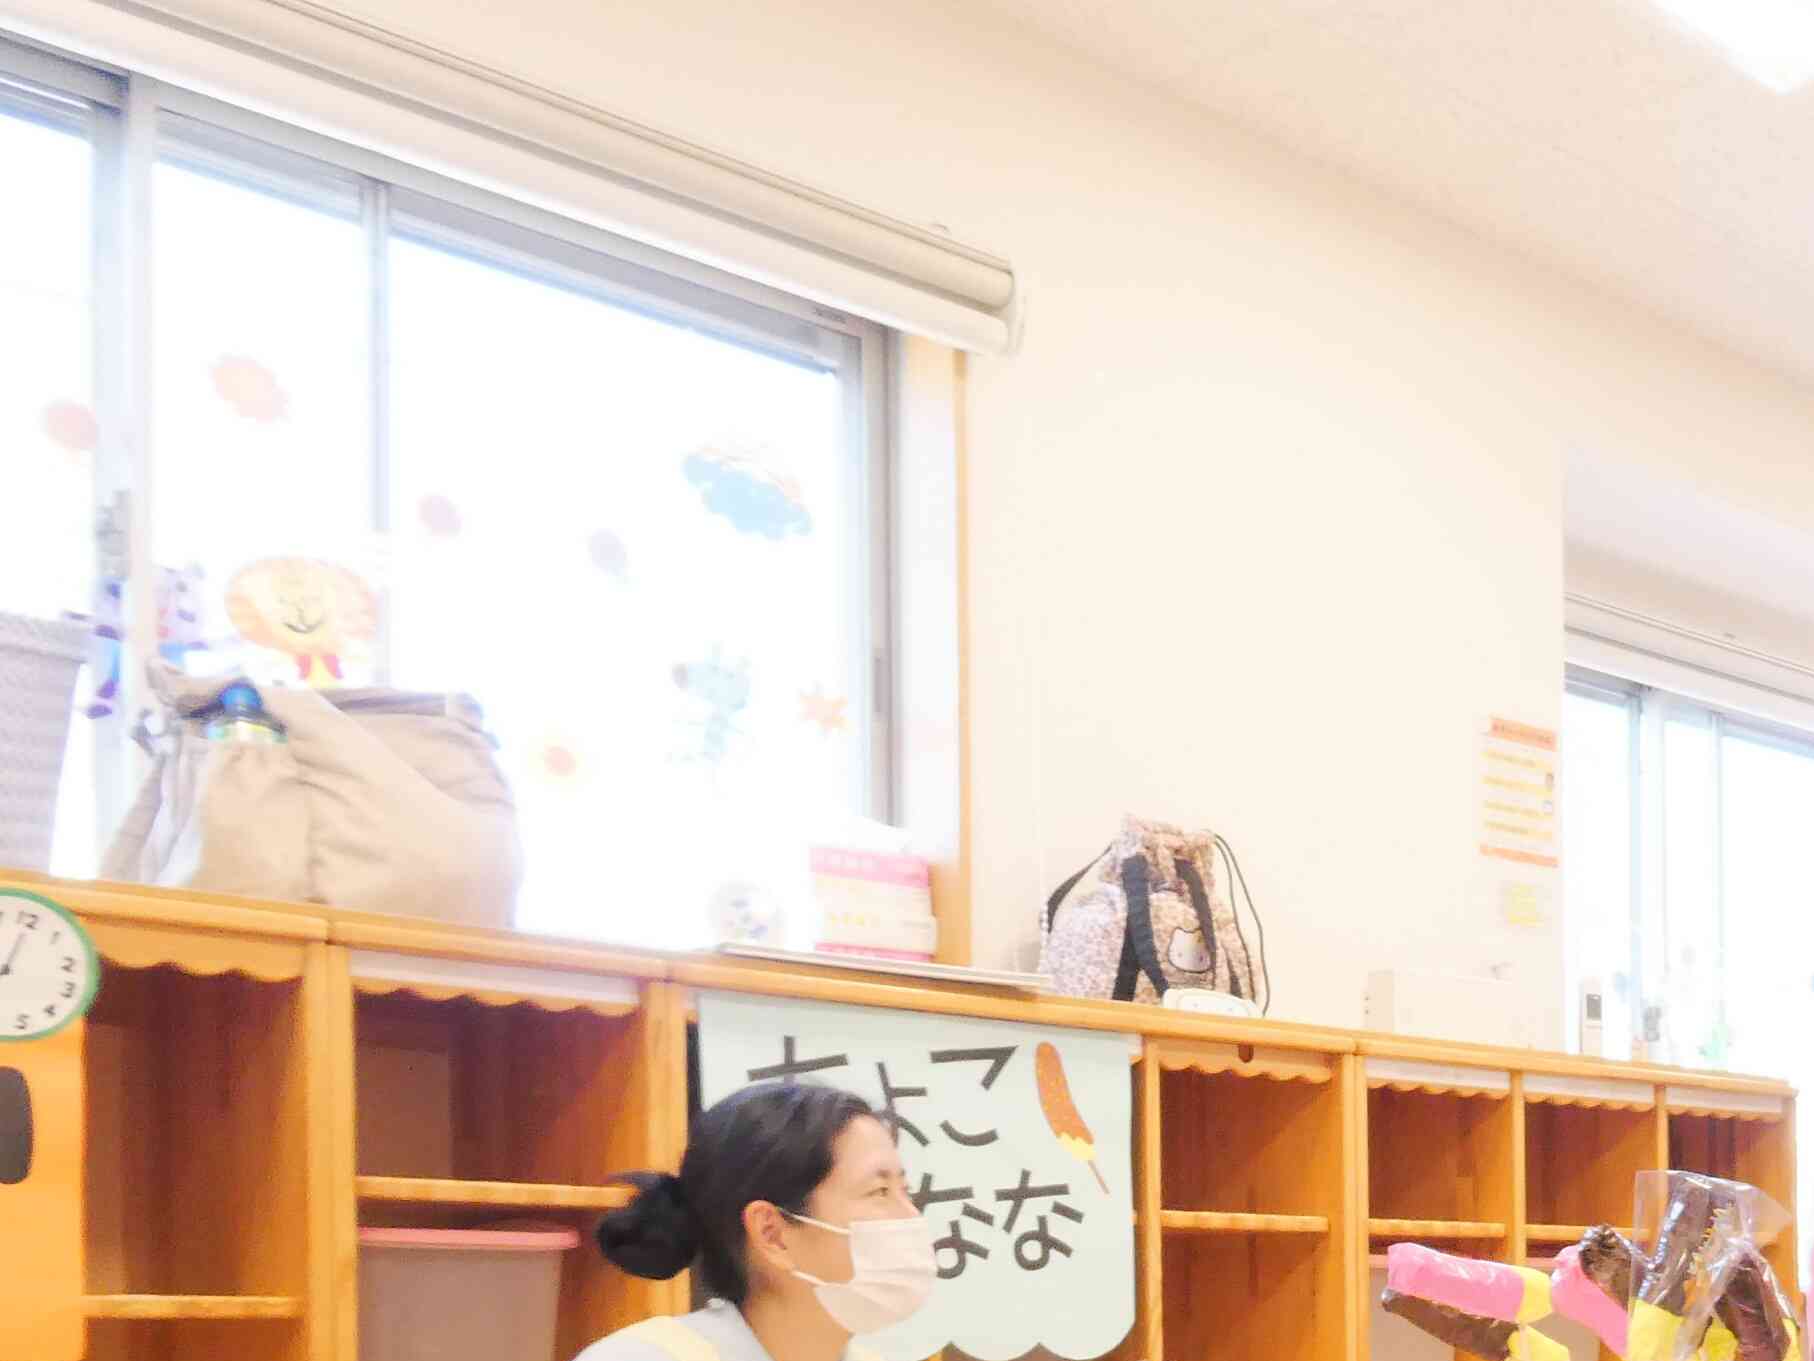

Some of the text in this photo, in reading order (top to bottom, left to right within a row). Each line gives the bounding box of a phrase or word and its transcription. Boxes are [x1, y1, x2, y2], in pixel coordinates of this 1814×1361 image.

[16, 910, 39, 931] 12
[60, 956, 76, 973] 2
[60, 981, 76, 999] 3
[13, 1013, 30, 1030] 5
[907, 1168, 1085, 1281] なな
